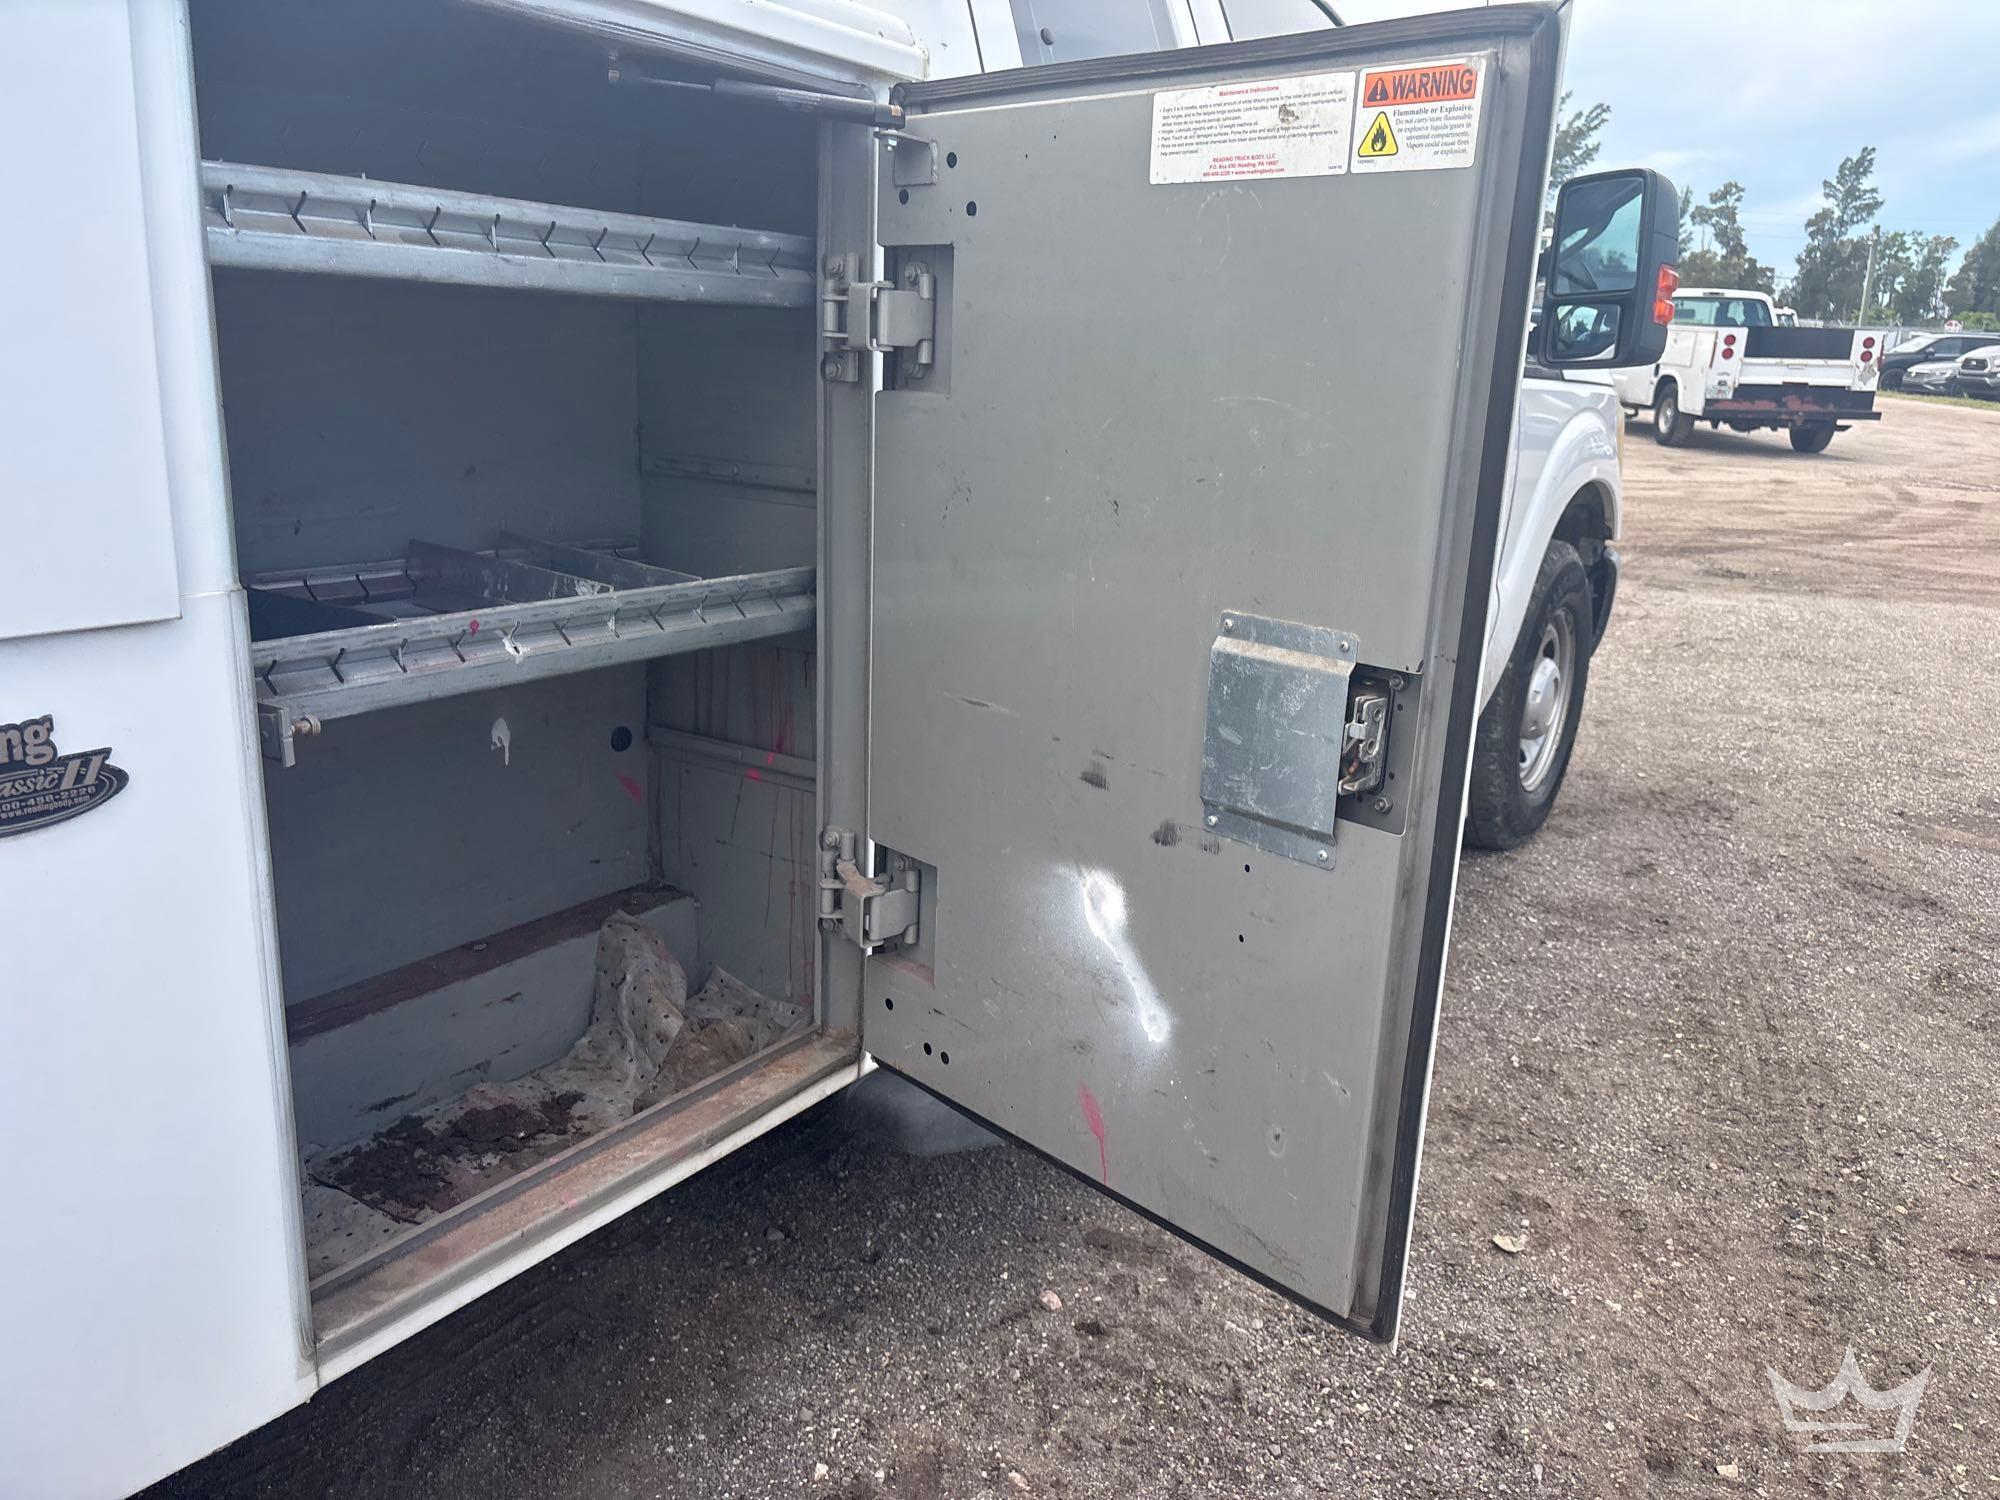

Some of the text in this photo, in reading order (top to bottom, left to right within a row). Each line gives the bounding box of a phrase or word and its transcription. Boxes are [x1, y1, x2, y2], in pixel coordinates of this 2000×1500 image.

[1392, 69, 1473, 100] WARNING
[1393, 109, 1429, 117] Flammable
[1396, 118, 1404, 126] Do
[1444, 114, 1473, 122] flammable
[1404, 126, 1430, 134] explosive
[1406, 142, 1424, 150] Vapors
[1440, 148, 1468, 157] explosion.
[1250, 153, 1265, 161] BODY,
[1237, 161, 1256, 169] Reading,
[1234, 167, 1285, 176] www.readingbody.com
